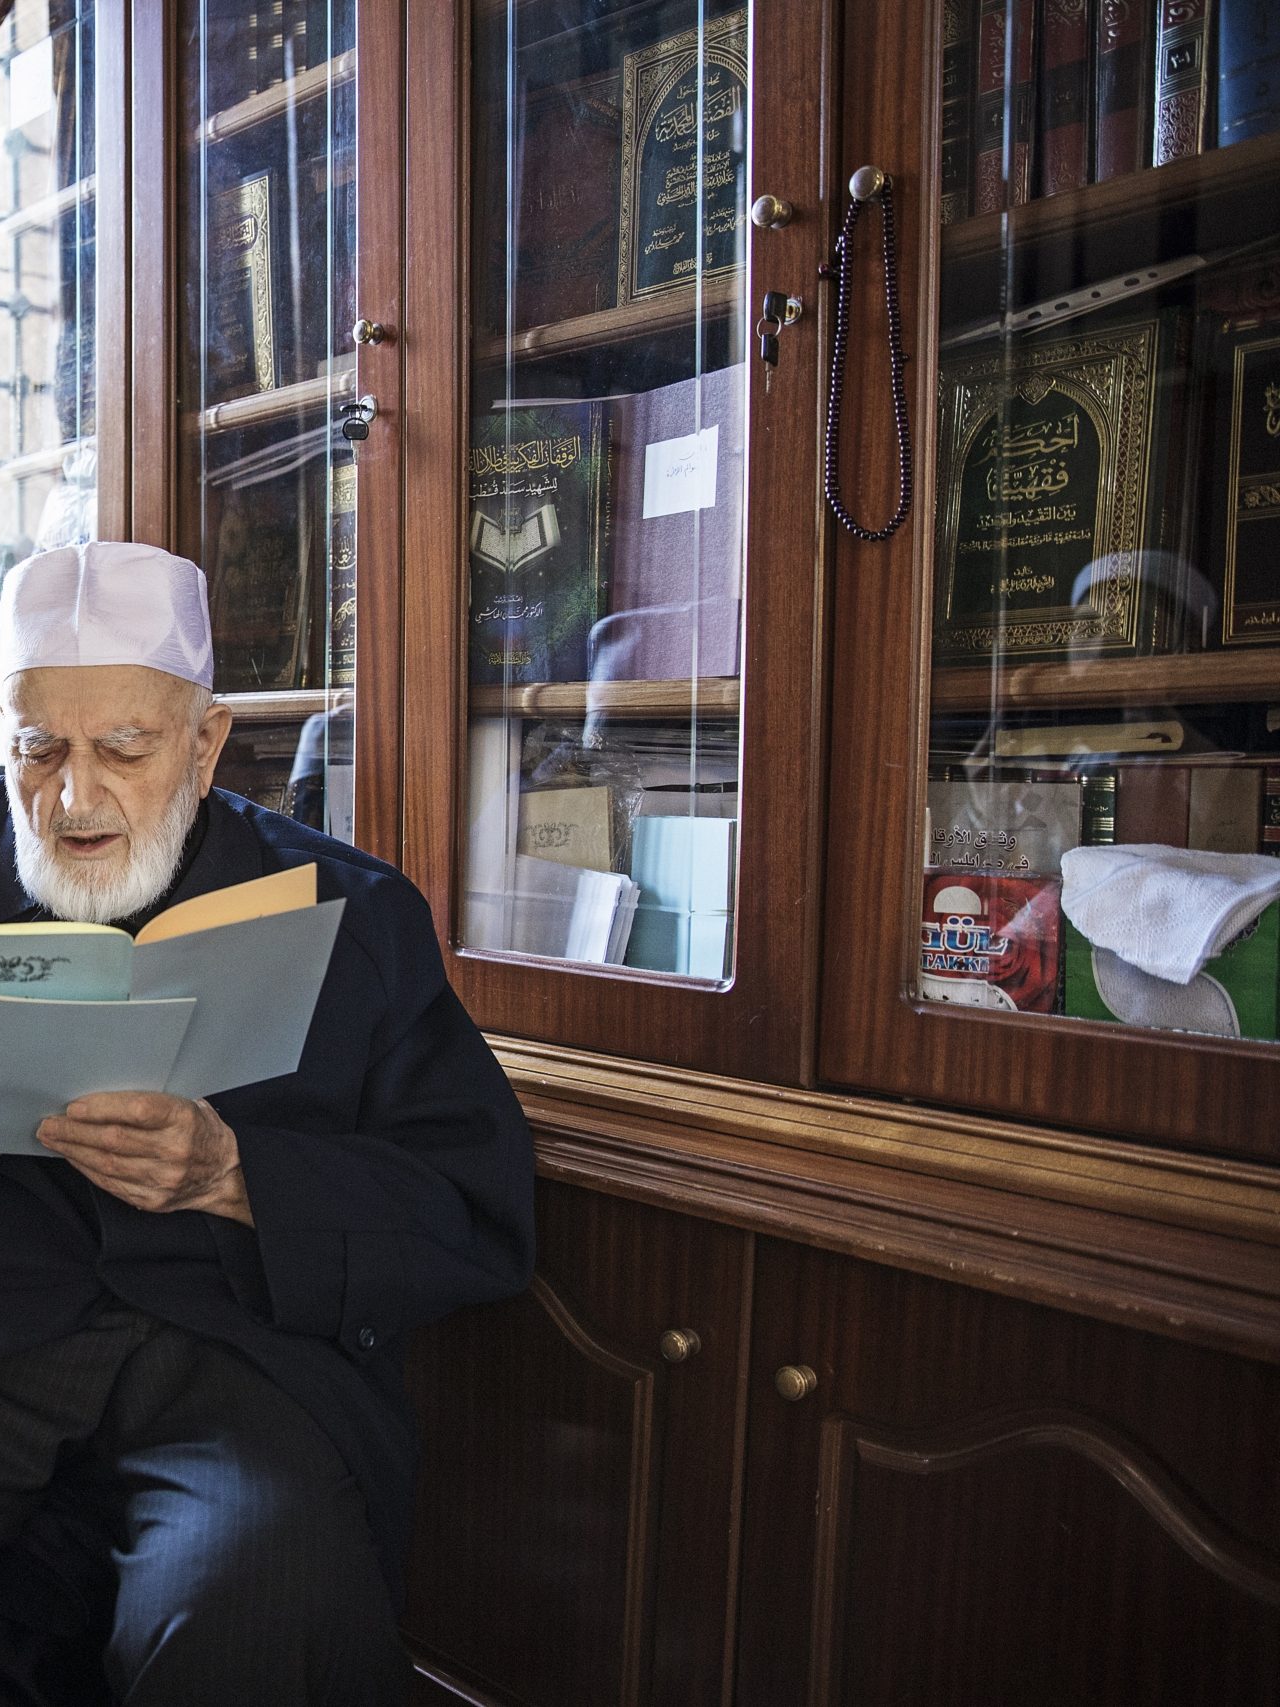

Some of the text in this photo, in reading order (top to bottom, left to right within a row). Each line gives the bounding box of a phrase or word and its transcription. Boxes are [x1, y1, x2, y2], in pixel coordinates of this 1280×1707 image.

[525, 474, 559, 498] للشهيد
[524, 602, 543, 618] الدكتور
[930, 825, 1018, 850] وثق الأوقا
